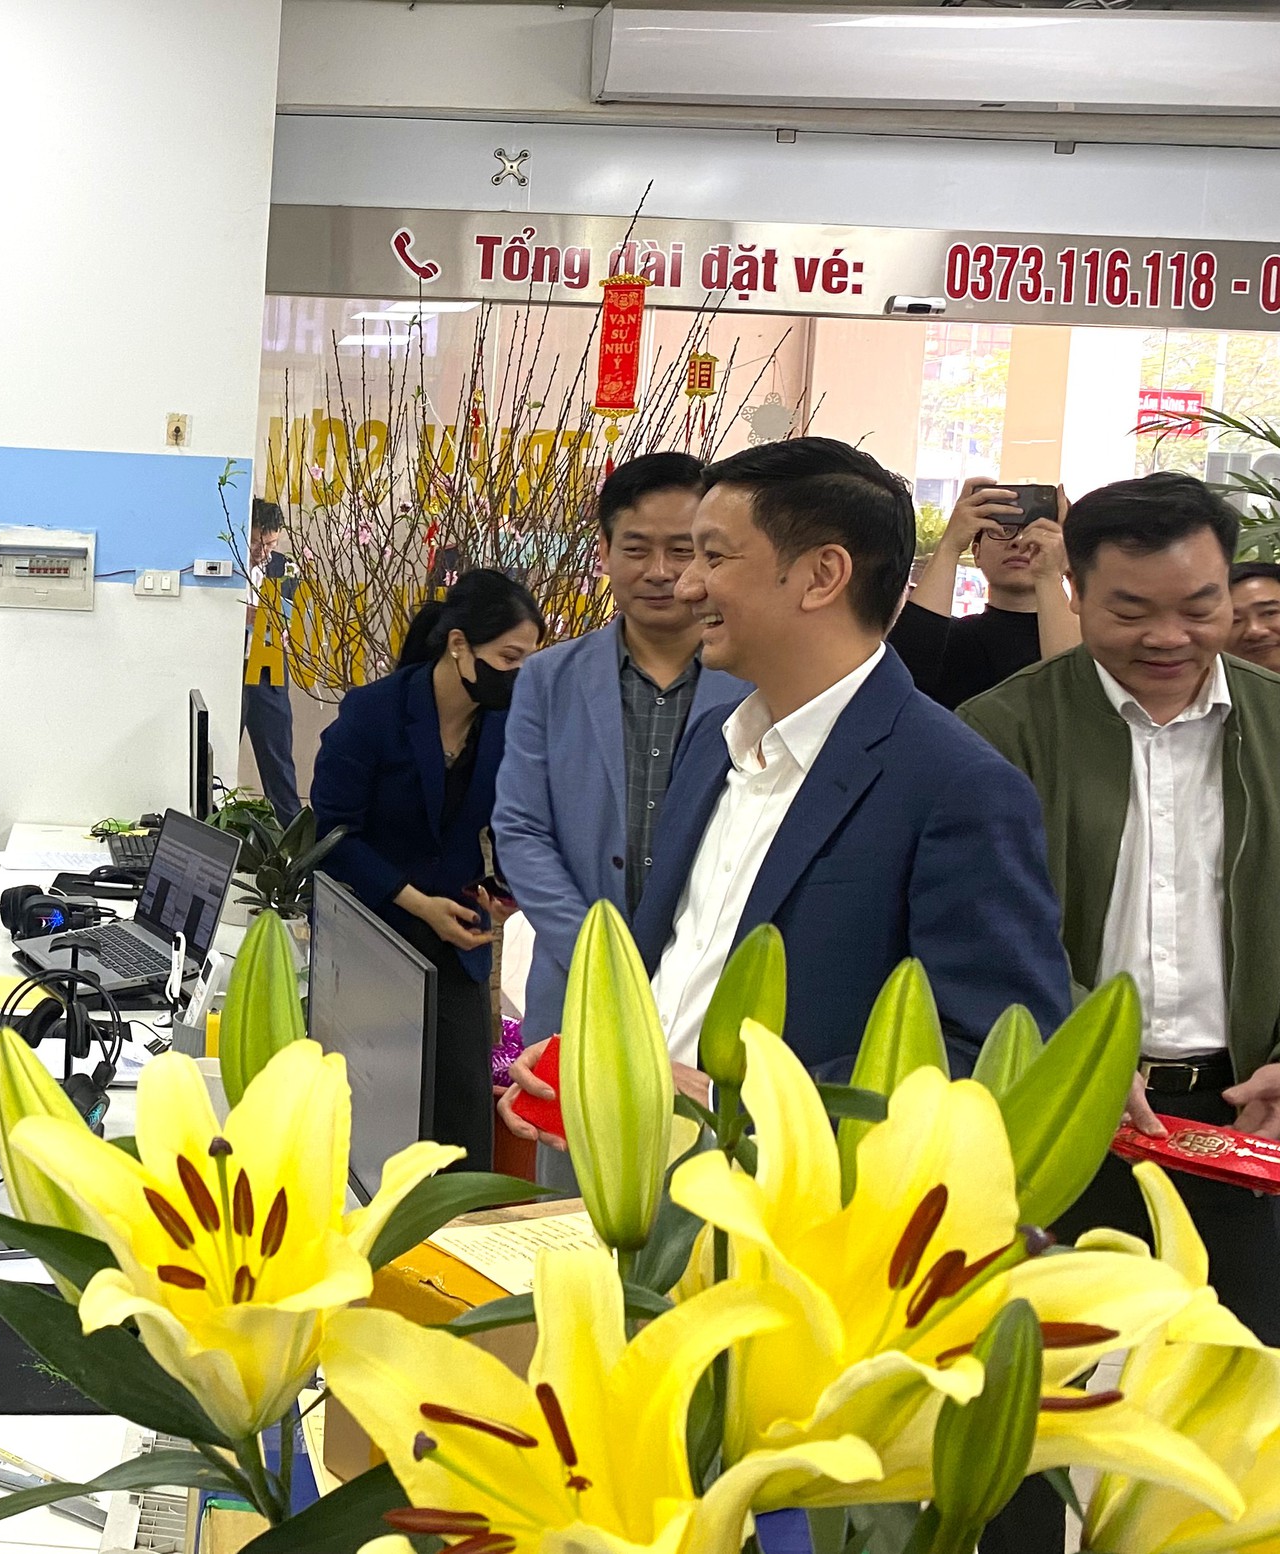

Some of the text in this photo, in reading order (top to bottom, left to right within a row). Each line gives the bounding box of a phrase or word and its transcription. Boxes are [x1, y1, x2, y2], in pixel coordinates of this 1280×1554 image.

[475, 227, 591, 289] Tổng
[608, 240, 683, 288] đài
[701, 243, 778, 301] đặt
[793, 247, 864, 295] vé:
[945, 243, 1217, 310] 0373.116.118
[609, 314, 637, 327] VẠN
[610, 327, 630, 341] SỰ
[605, 341, 634, 354] NHƯ
[613, 355, 623, 369] Ý
